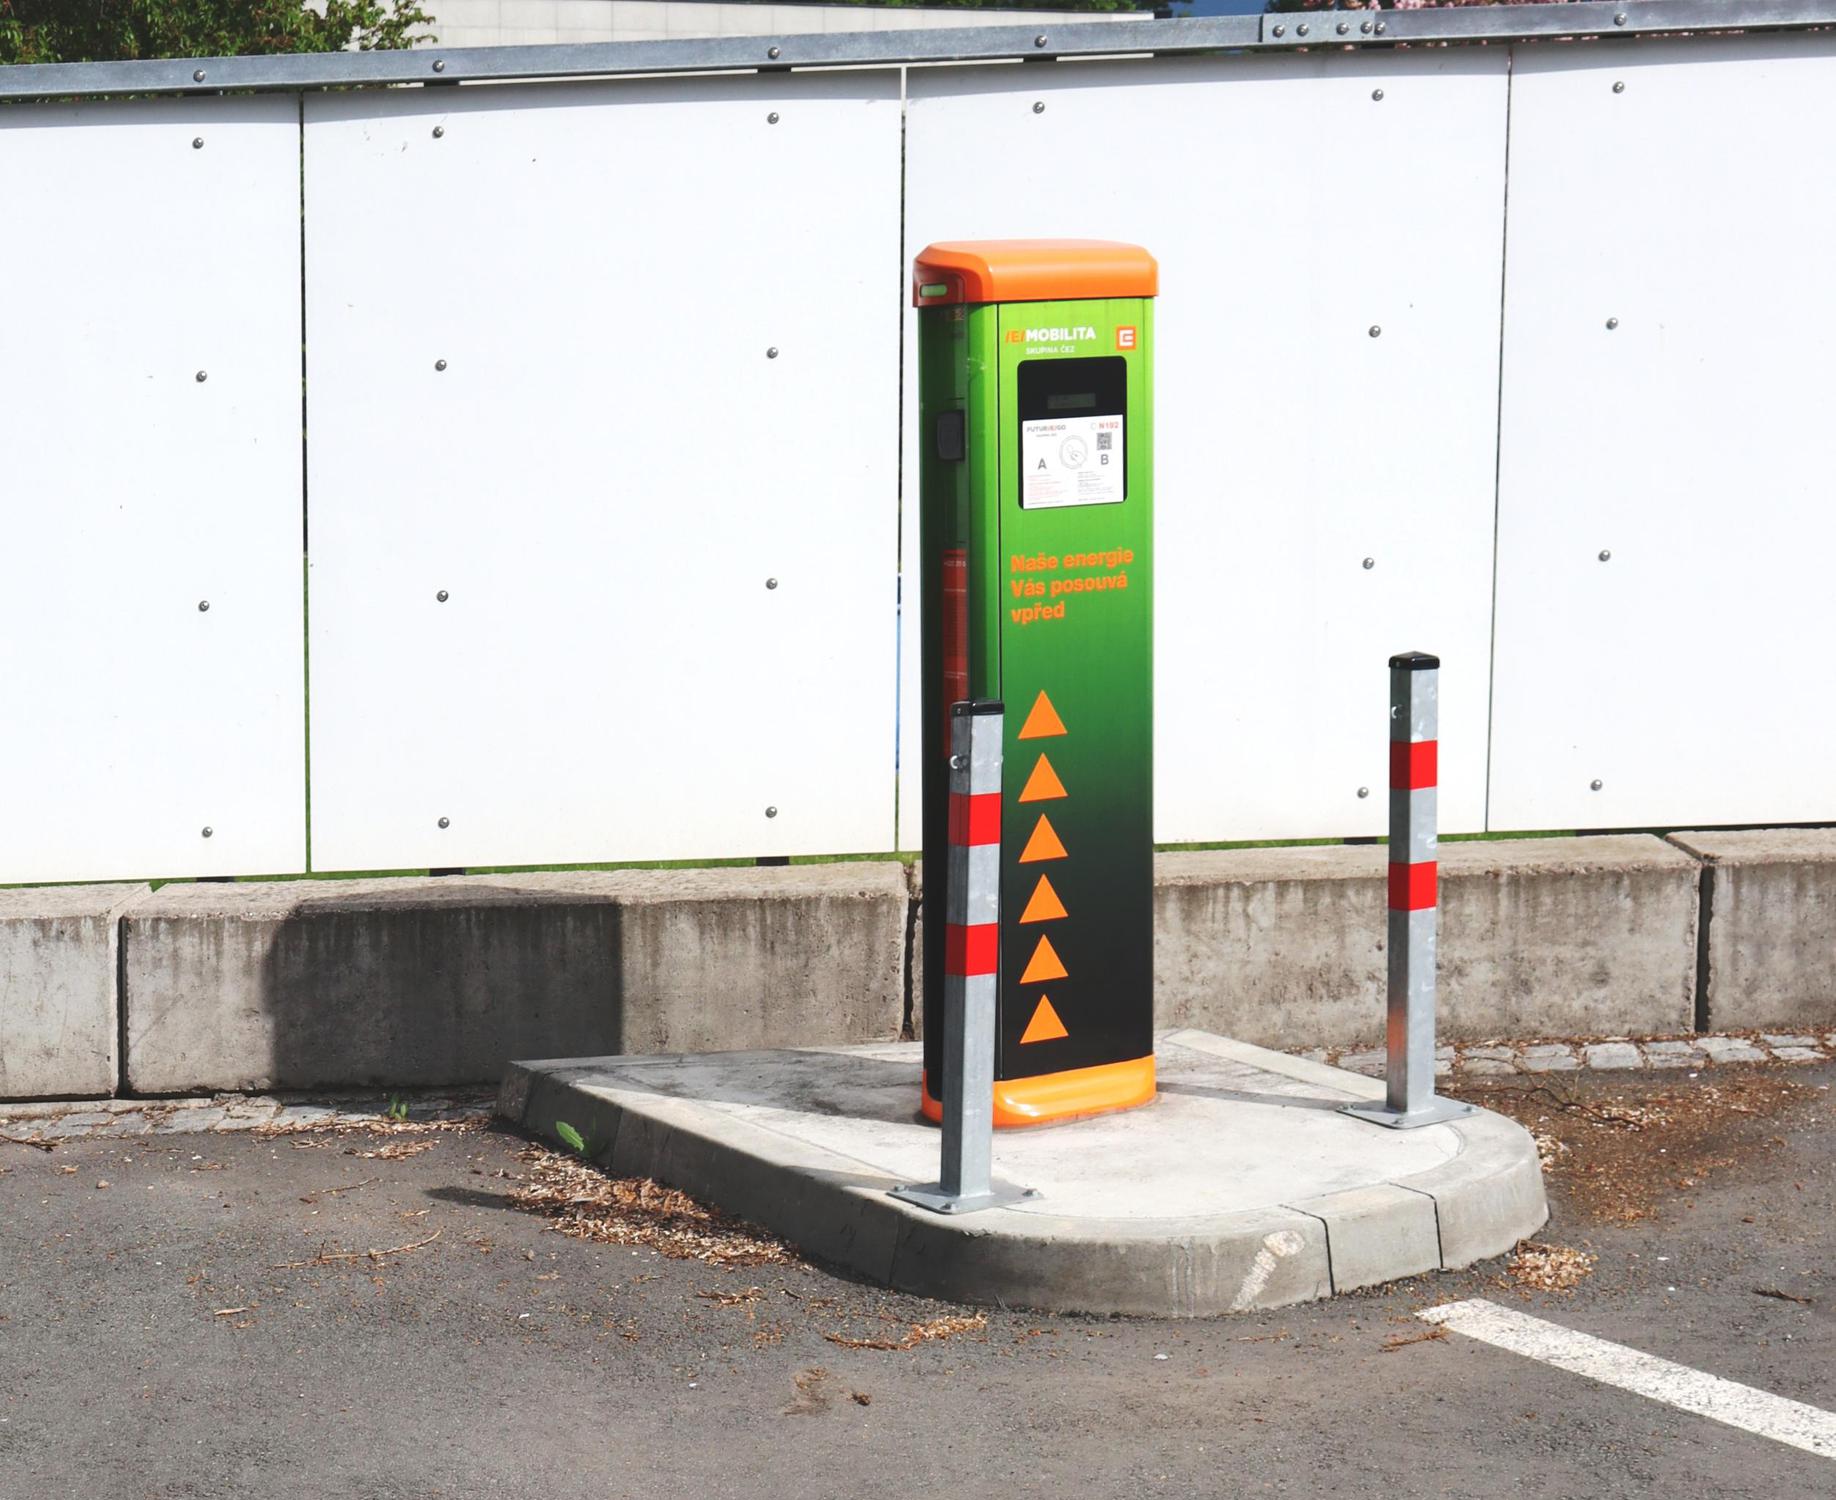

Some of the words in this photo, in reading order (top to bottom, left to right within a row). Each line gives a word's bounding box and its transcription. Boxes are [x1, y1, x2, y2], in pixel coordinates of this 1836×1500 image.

[1037, 458, 1047, 470] A
[1101, 454, 1110, 466] B
[1010, 552, 1058, 573] Naše
[1063, 547, 1134, 569] energie
[1011, 579, 1046, 598] Vás
[1050, 571, 1128, 597] posouvá
[1011, 601, 1065, 625] vpřed
